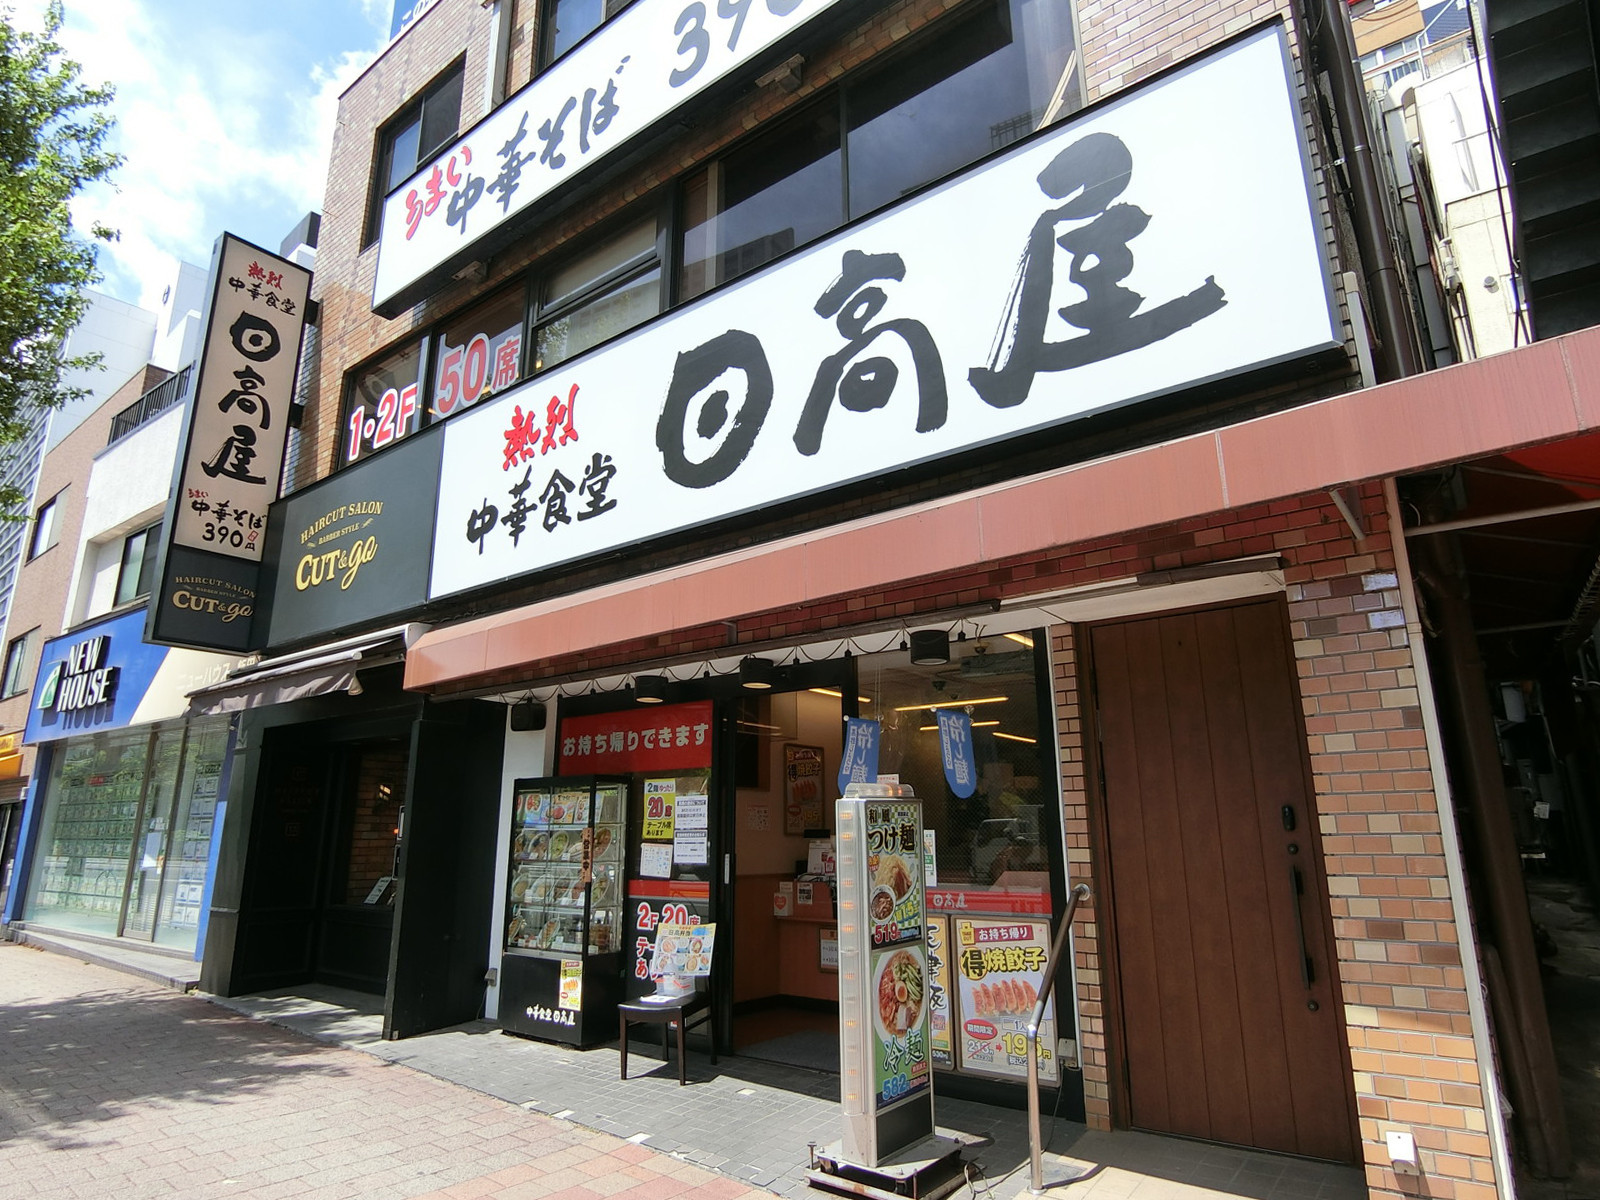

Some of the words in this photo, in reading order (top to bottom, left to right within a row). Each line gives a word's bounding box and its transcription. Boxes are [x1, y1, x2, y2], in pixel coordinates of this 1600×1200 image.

[446, 55, 631, 235] 中華そば
[406, 145, 472, 240] うまい
[248, 260, 283, 290] 熱烈
[228, 276, 297, 317] 中華食堂
[656, 132, 1228, 489] 日高屋
[200, 310, 281, 485] 日高屋
[502, 383, 580, 471] 熱烈
[191, 499, 267, 530] 中華そば
[300, 505, 347, 544] HAIRCUT
[348, 501, 384, 516] SALON
[466, 452, 617, 555] 中華食堂
[318, 529, 341, 545] BARBER
[341, 522, 360, 536] STYLE
[175, 576, 223, 586] HAIRCUT
[225, 581, 257, 599] SALON
[64, 635, 110, 677] NEW
[57, 667, 117, 712] HOUSE
[563, 723, 709, 757] お持ち帰りできます
[868, 822, 916, 853] つけ麺
[637, 902, 659, 931] 2F
[933, 892, 968, 909] 日高屋
[978, 927, 1028, 941] お持ち帰り
[883, 1028, 924, 1074] 冷麺
